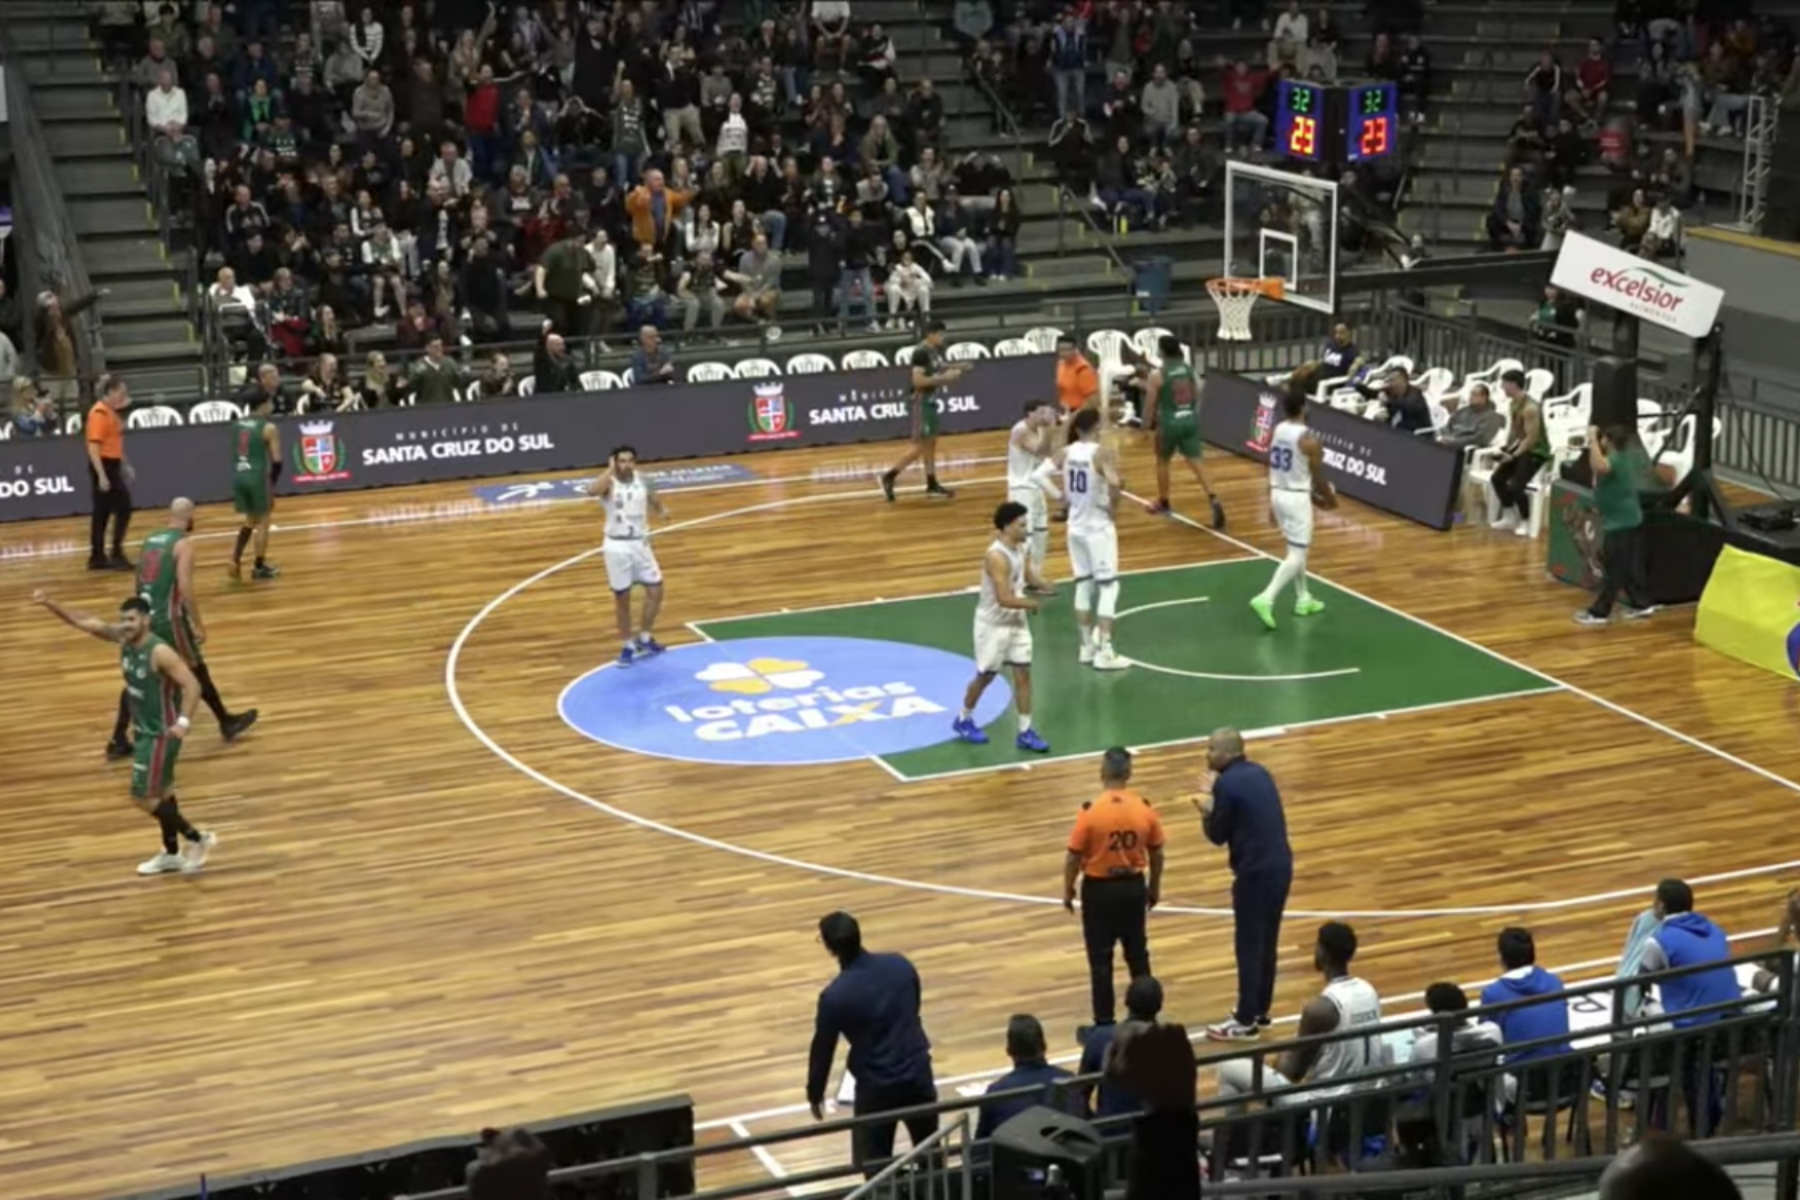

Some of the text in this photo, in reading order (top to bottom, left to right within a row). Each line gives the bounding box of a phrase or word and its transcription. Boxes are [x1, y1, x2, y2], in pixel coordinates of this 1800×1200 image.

[1291, 115, 1316, 155] 23
[1361, 116, 1387, 155] 23
[1590, 266, 1684, 312] excelsior
[809, 404, 868, 426] SANTA
[870, 401, 908, 420] CRU
[948, 394, 980, 413] SUL
[362, 432, 555, 466] SANTA CRUZ DO SUL
[1271, 445, 1293, 472] 33
[1321, 447, 1388, 487] RUZ DO SUL
[0, 474, 75, 498] DO SUL
[1069, 468, 1088, 494] 10
[665, 681, 916, 722] loterias
[695, 695, 948, 741] CAIXA
[1109, 830, 1138, 852] 20
